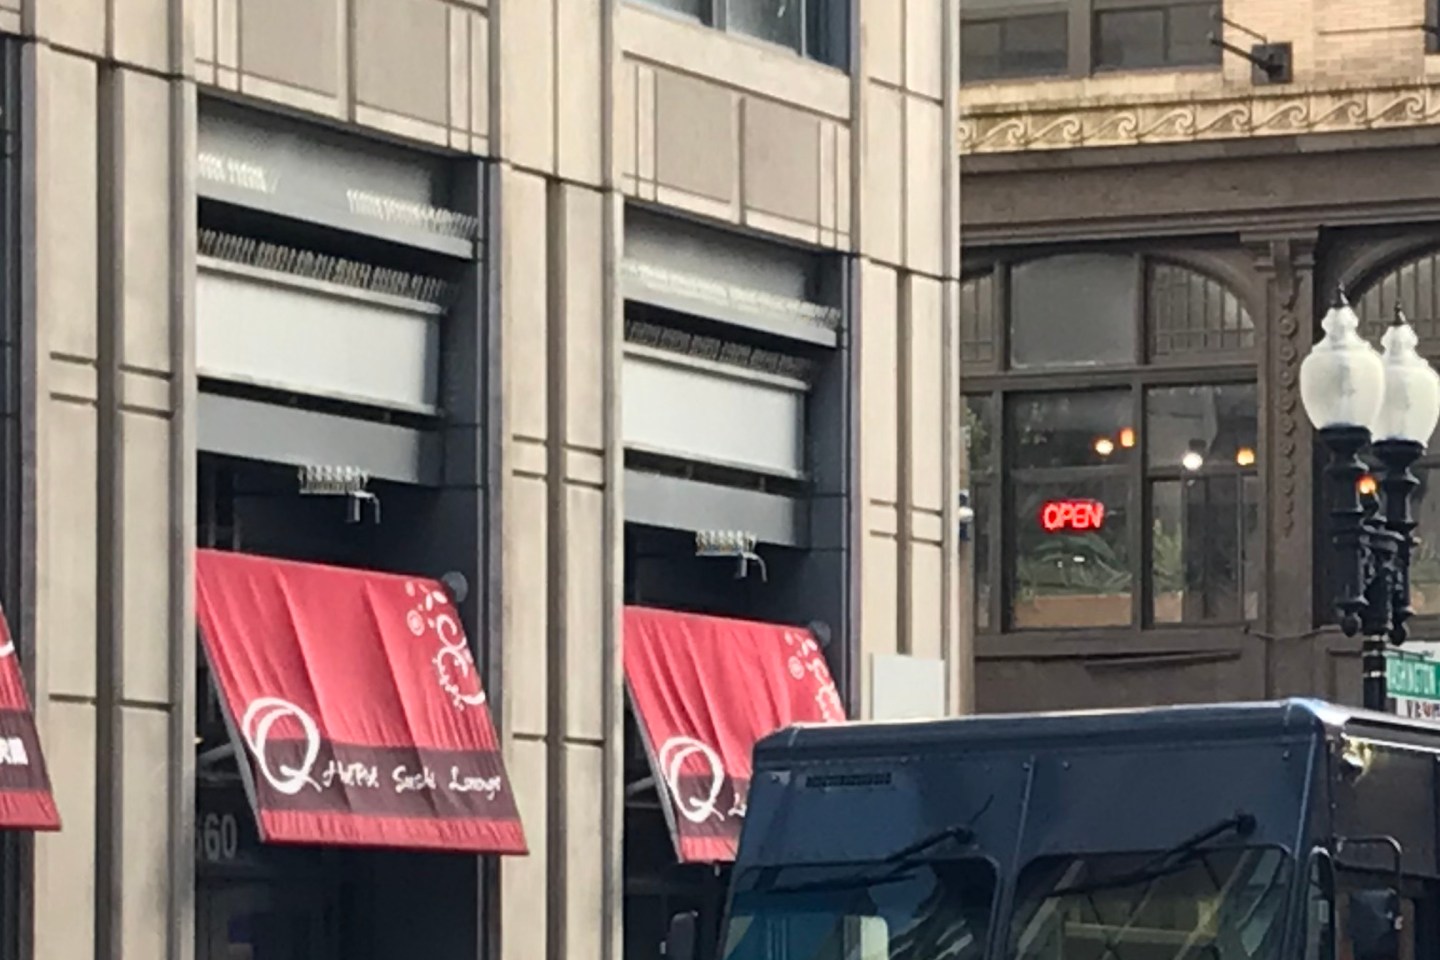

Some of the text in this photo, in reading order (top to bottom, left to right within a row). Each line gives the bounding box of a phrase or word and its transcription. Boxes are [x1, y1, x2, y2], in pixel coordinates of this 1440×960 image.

[1043, 502, 1104, 529] OPEN
[241, 696, 323, 795] Q
[659, 735, 725, 824] Q
